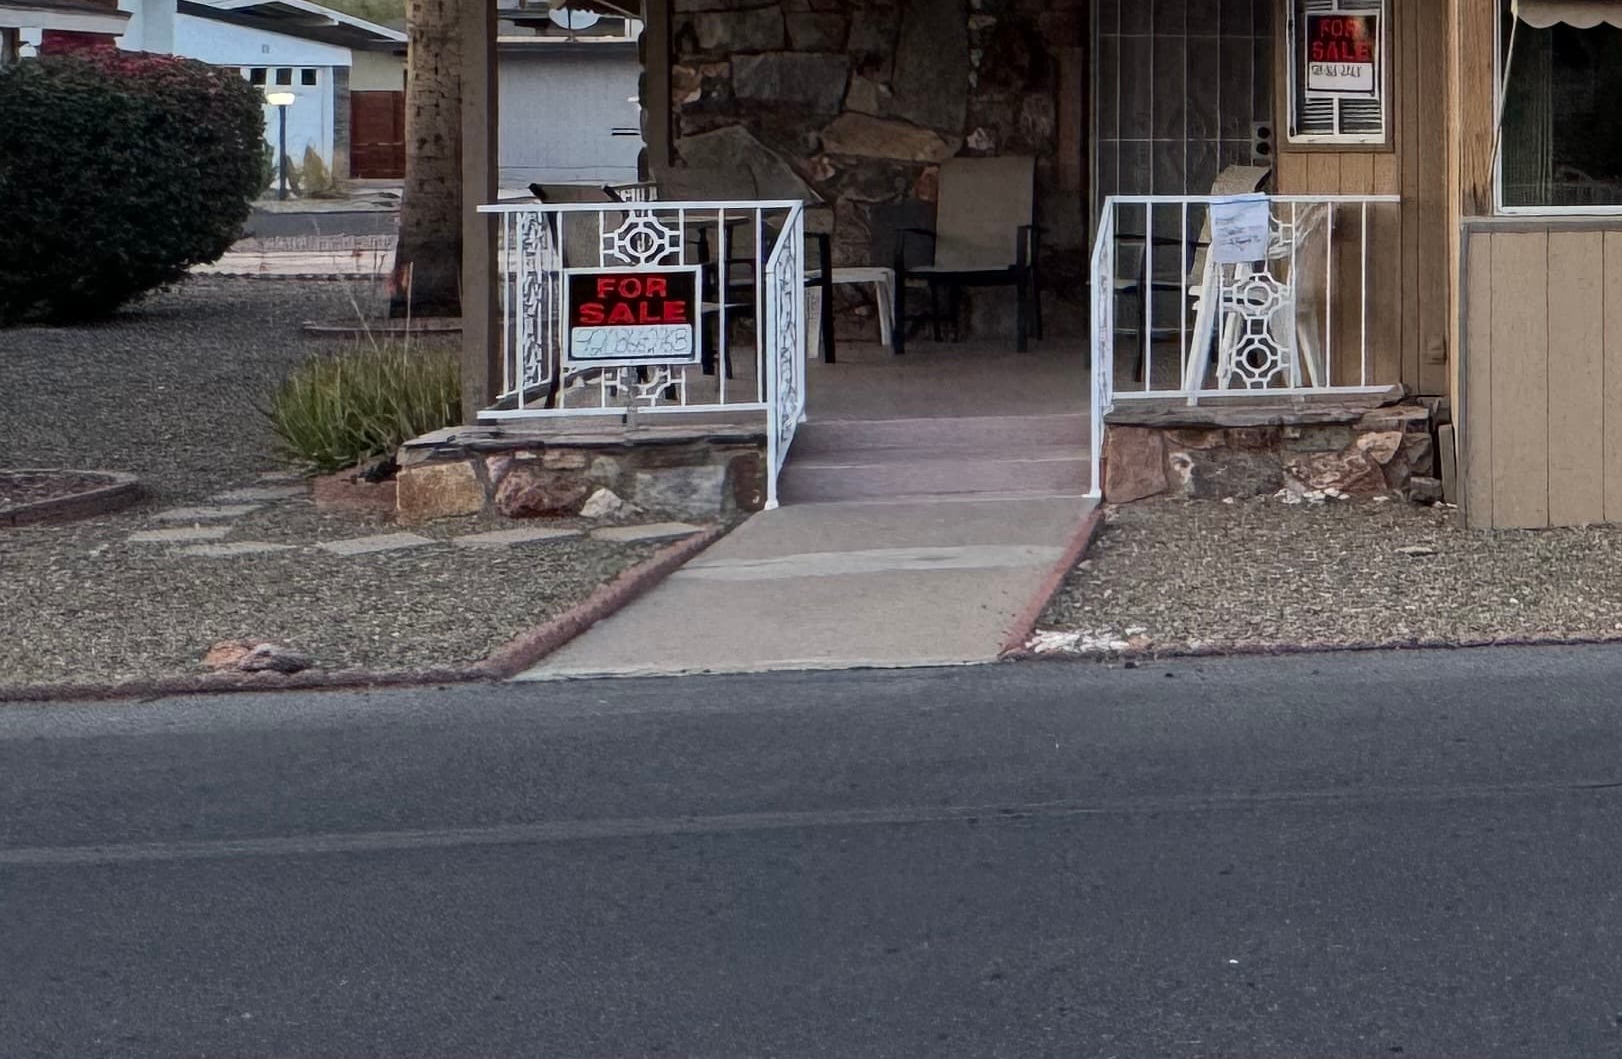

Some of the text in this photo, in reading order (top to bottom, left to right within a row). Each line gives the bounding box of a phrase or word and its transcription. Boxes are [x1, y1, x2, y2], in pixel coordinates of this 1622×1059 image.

[1319, 19, 1362, 38] FOR
[1312, 40, 1369, 61] SALE
[597, 277, 667, 298] FOR
[579, 300, 687, 324] SALE
